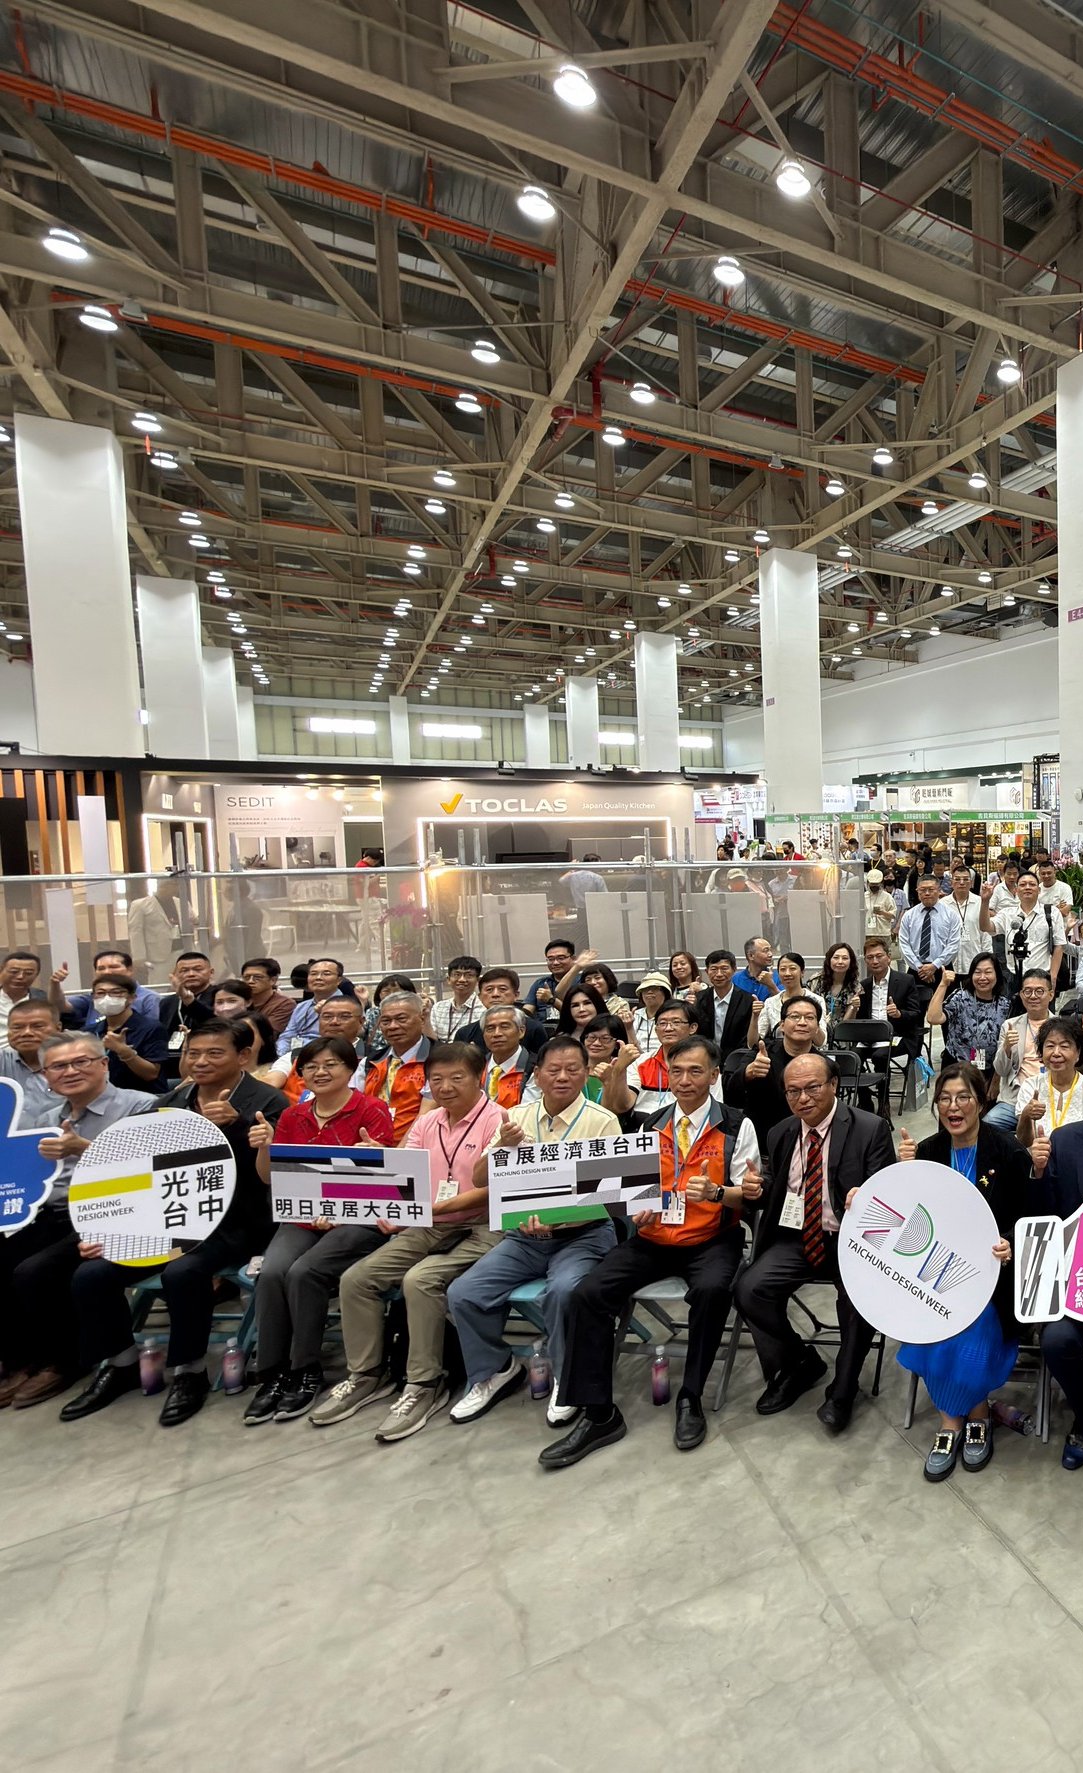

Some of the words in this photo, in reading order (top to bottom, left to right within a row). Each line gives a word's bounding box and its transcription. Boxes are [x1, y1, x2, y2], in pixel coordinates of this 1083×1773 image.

[226, 796, 275, 807] SEDIT
[464, 798, 568, 814] TOCLAS
[582, 802, 603, 810] Japan
[603, 802, 629, 811] Quality
[491, 1134, 654, 1168] 會展經濟惠台中
[161, 1164, 225, 1200] 光耀
[493, 1170, 520, 1178] TAICHUNG
[521, 1168, 541, 1176] DESIGN
[77, 1199, 122, 1213] TAICHUNG
[77, 1210, 110, 1222] DESIGN
[110, 1206, 135, 1217] WEEK
[163, 1194, 224, 1229] 台中
[275, 1198, 424, 1220] 明日宜居大台中
[847, 1238, 892, 1276] TAICHUNG
[891, 1271, 926, 1300] DESIGN
[925, 1295, 952, 1320] WEEK
